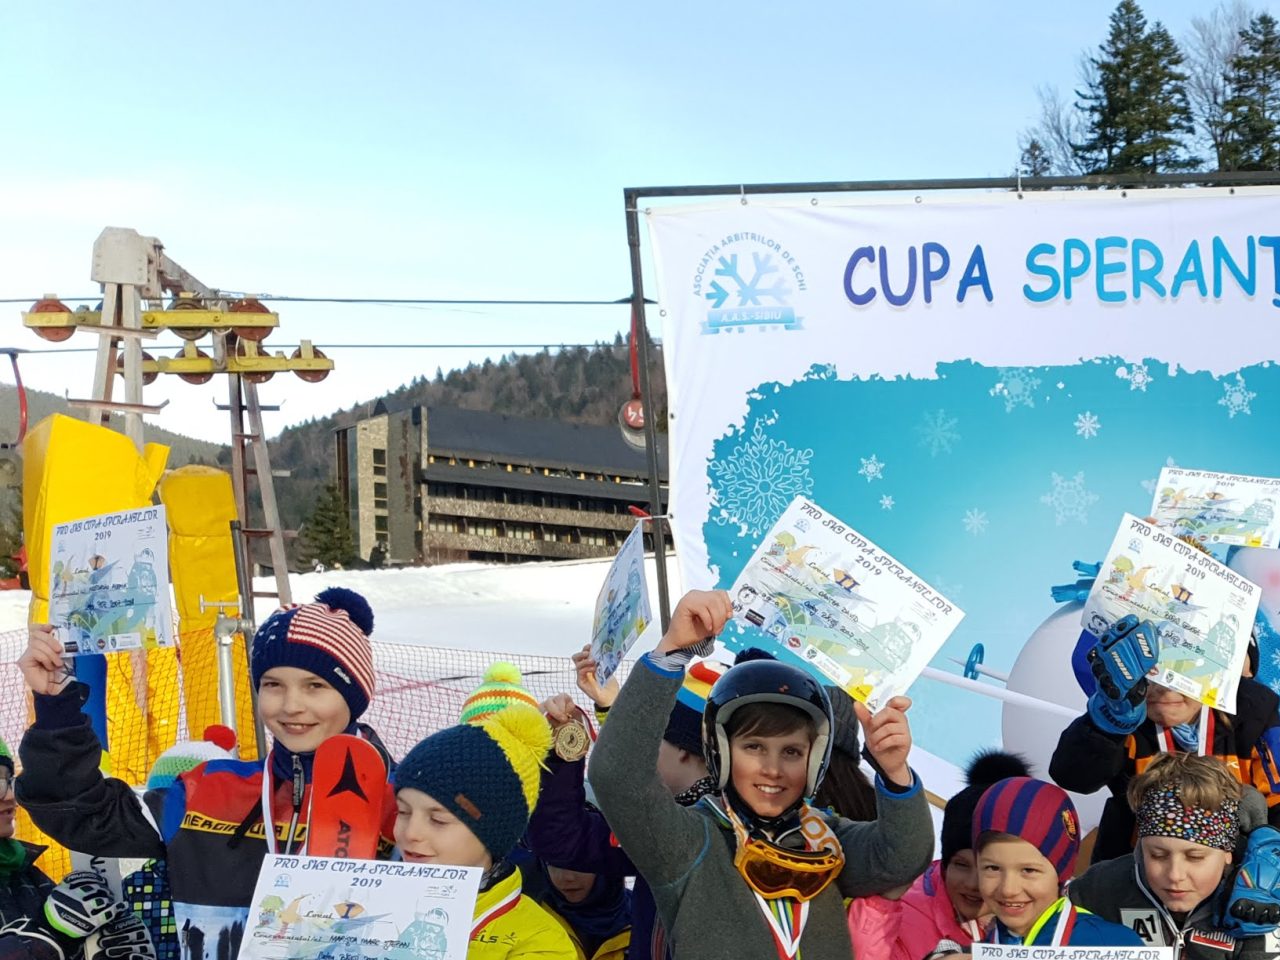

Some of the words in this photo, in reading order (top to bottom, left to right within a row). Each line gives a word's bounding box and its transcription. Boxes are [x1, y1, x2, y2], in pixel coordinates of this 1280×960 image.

[781, 250, 796, 265] DE
[843, 242, 994, 306] CUPA
[94, 531, 112, 541] 2019
[855, 554, 883, 577] 2019
[1185, 564, 1206, 580] 2019
[836, 575, 860, 593] II
[1177, 587, 1194, 605] II
[273, 857, 299, 869] PRO
[351, 878, 382, 888] 2019
[340, 903, 356, 919] I
[1132, 915, 1157, 942] A1
[981, 947, 1004, 958] PRO
